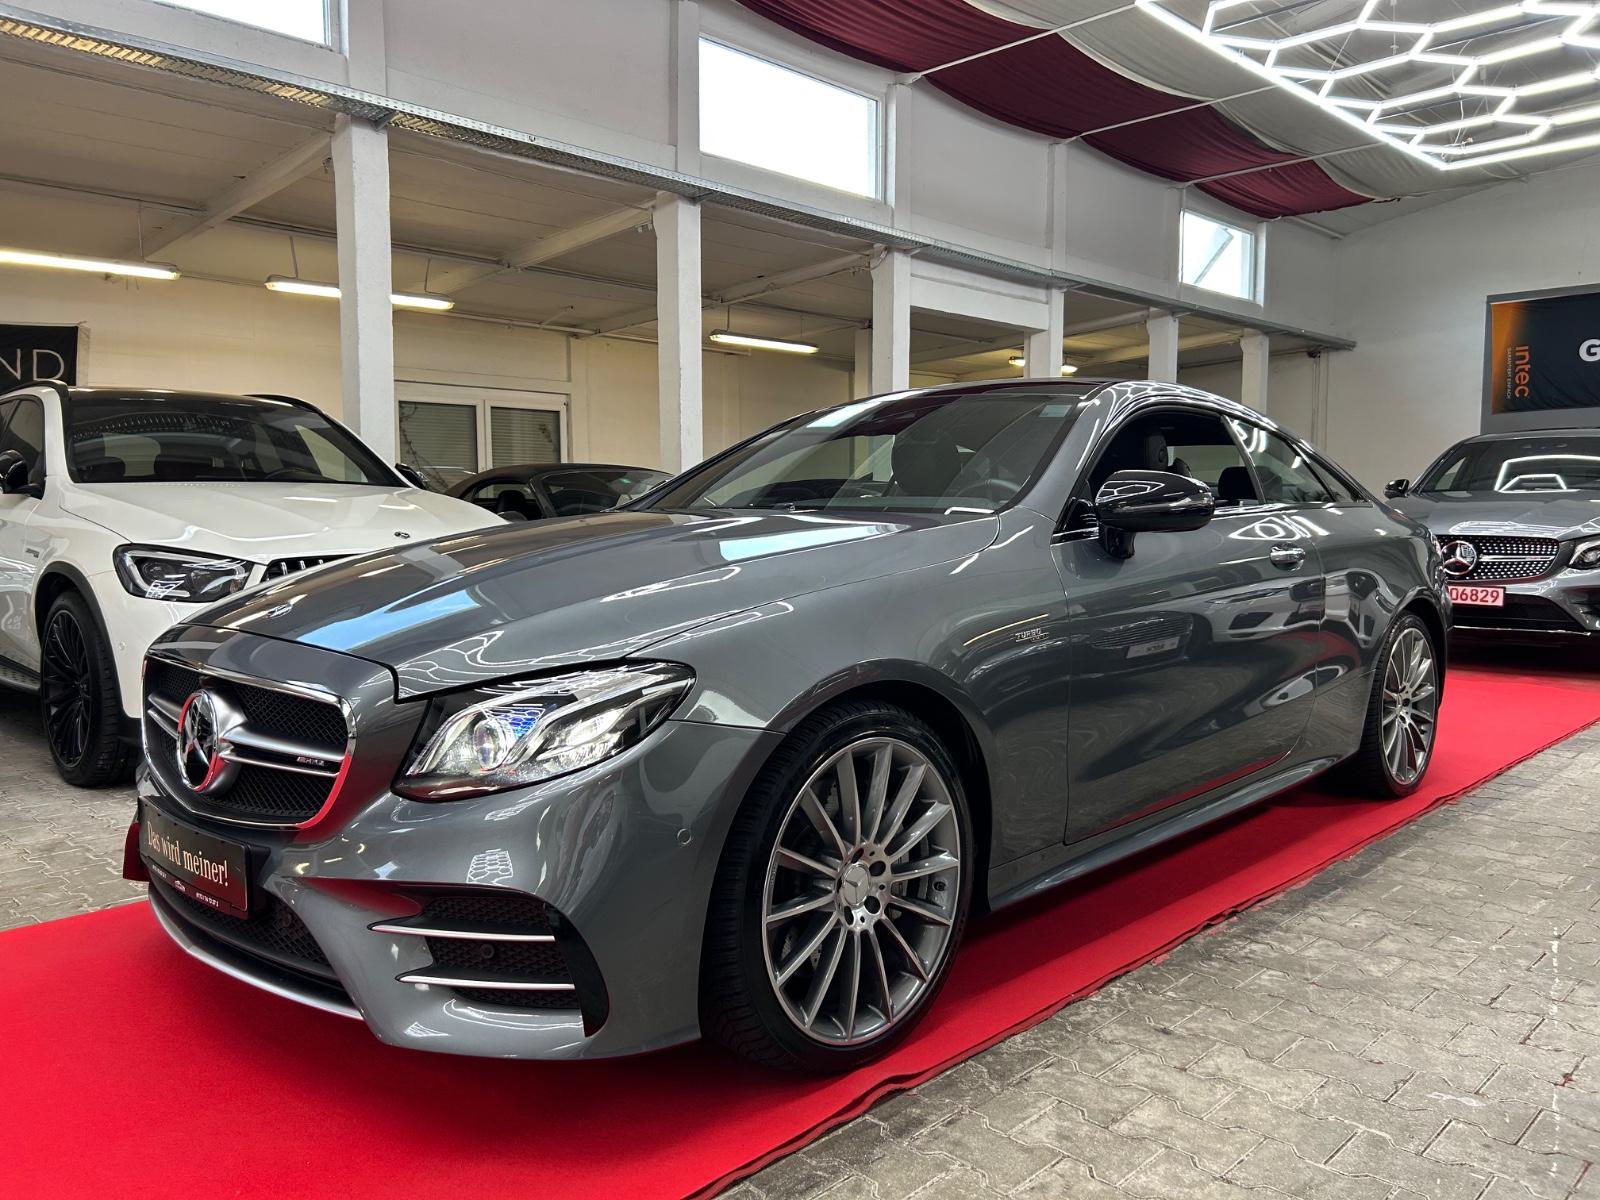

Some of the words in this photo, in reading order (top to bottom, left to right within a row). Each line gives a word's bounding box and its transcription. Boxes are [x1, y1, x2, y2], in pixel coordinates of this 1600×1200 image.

[1514, 345, 1531, 398] intec
[1450, 588, 1499, 603] 06829
[147, 821, 160, 852] Das
[162, 836, 181, 866] wird
[183, 851, 229, 887] meiner!
